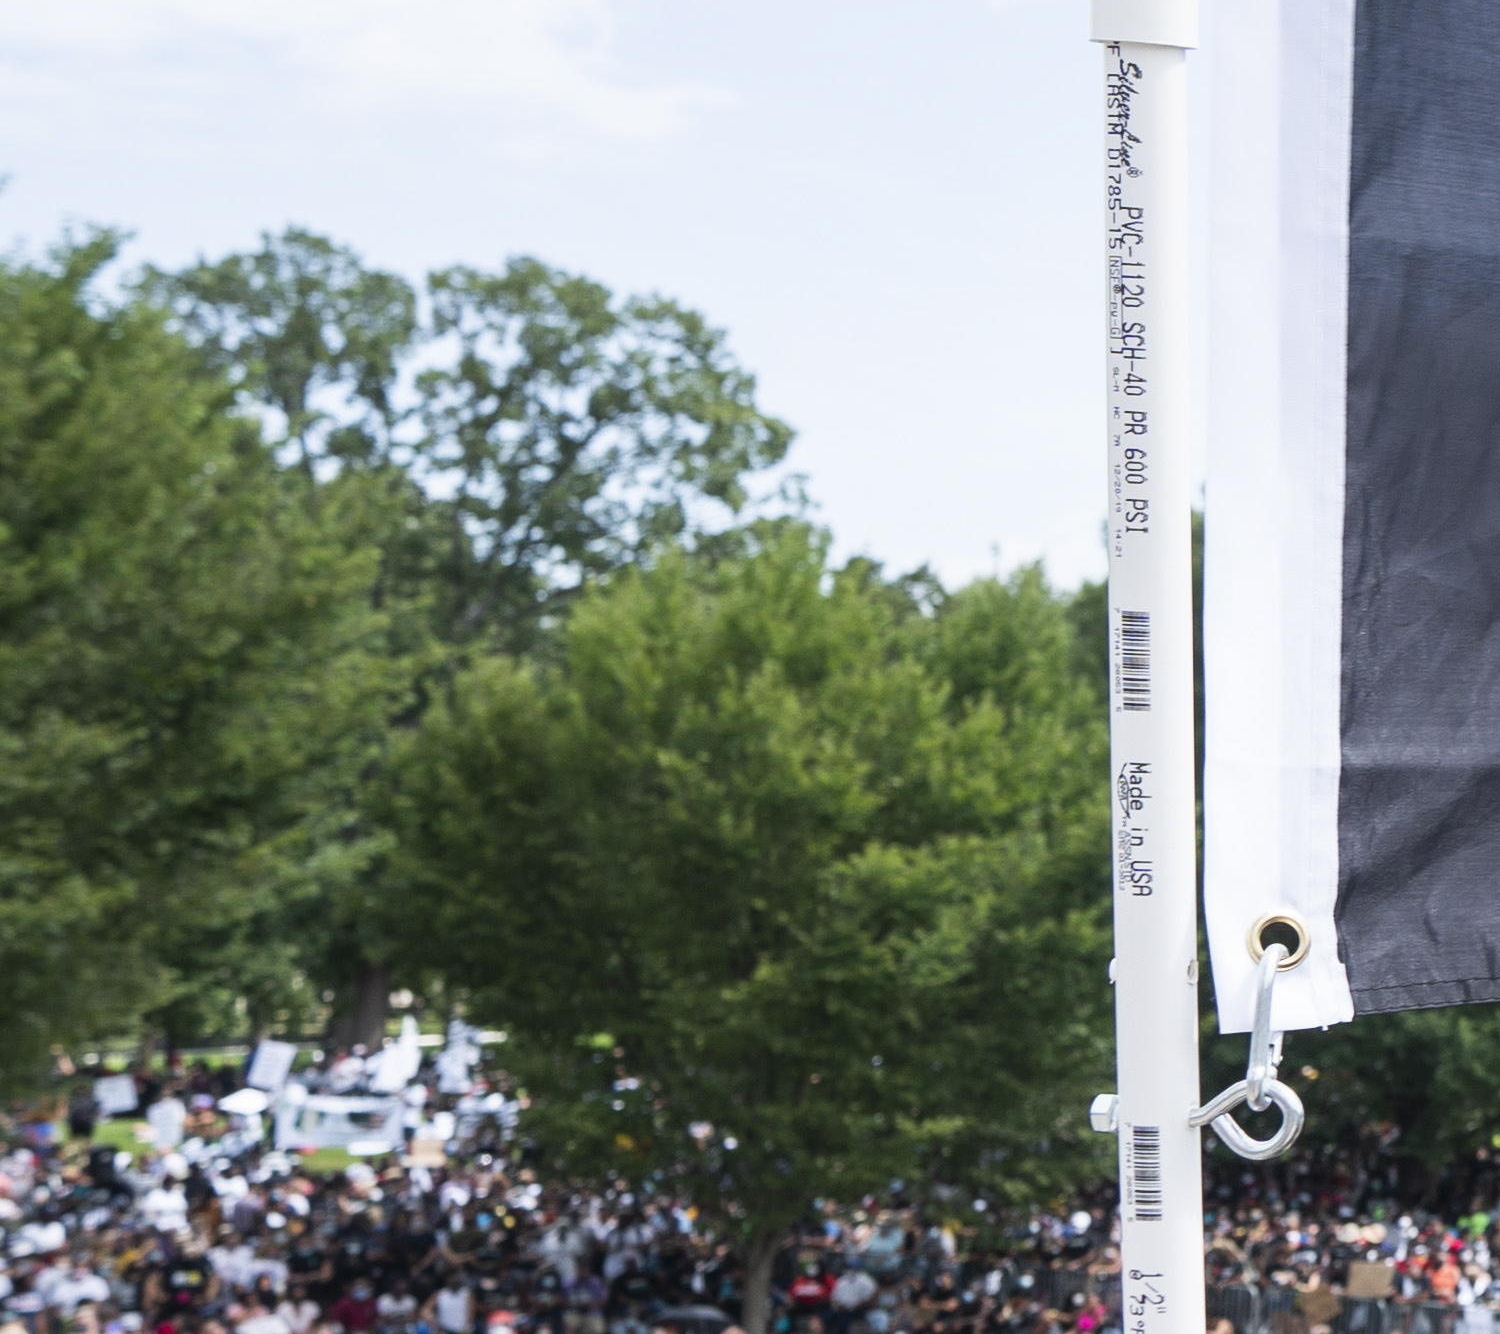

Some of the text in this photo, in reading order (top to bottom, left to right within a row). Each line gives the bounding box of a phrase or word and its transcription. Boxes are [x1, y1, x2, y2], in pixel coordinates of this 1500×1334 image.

[1108, 148, 1122, 249] D1785-15
[1119, 206, 1146, 308] PVC-1120
[1122, 322, 1148, 396] SCH-40
[1124, 411, 1149, 435] PR
[1124, 448, 1149, 484] 600
[1125, 499, 1150, 534] PSI
[1129, 762, 1153, 898] Made in USA
